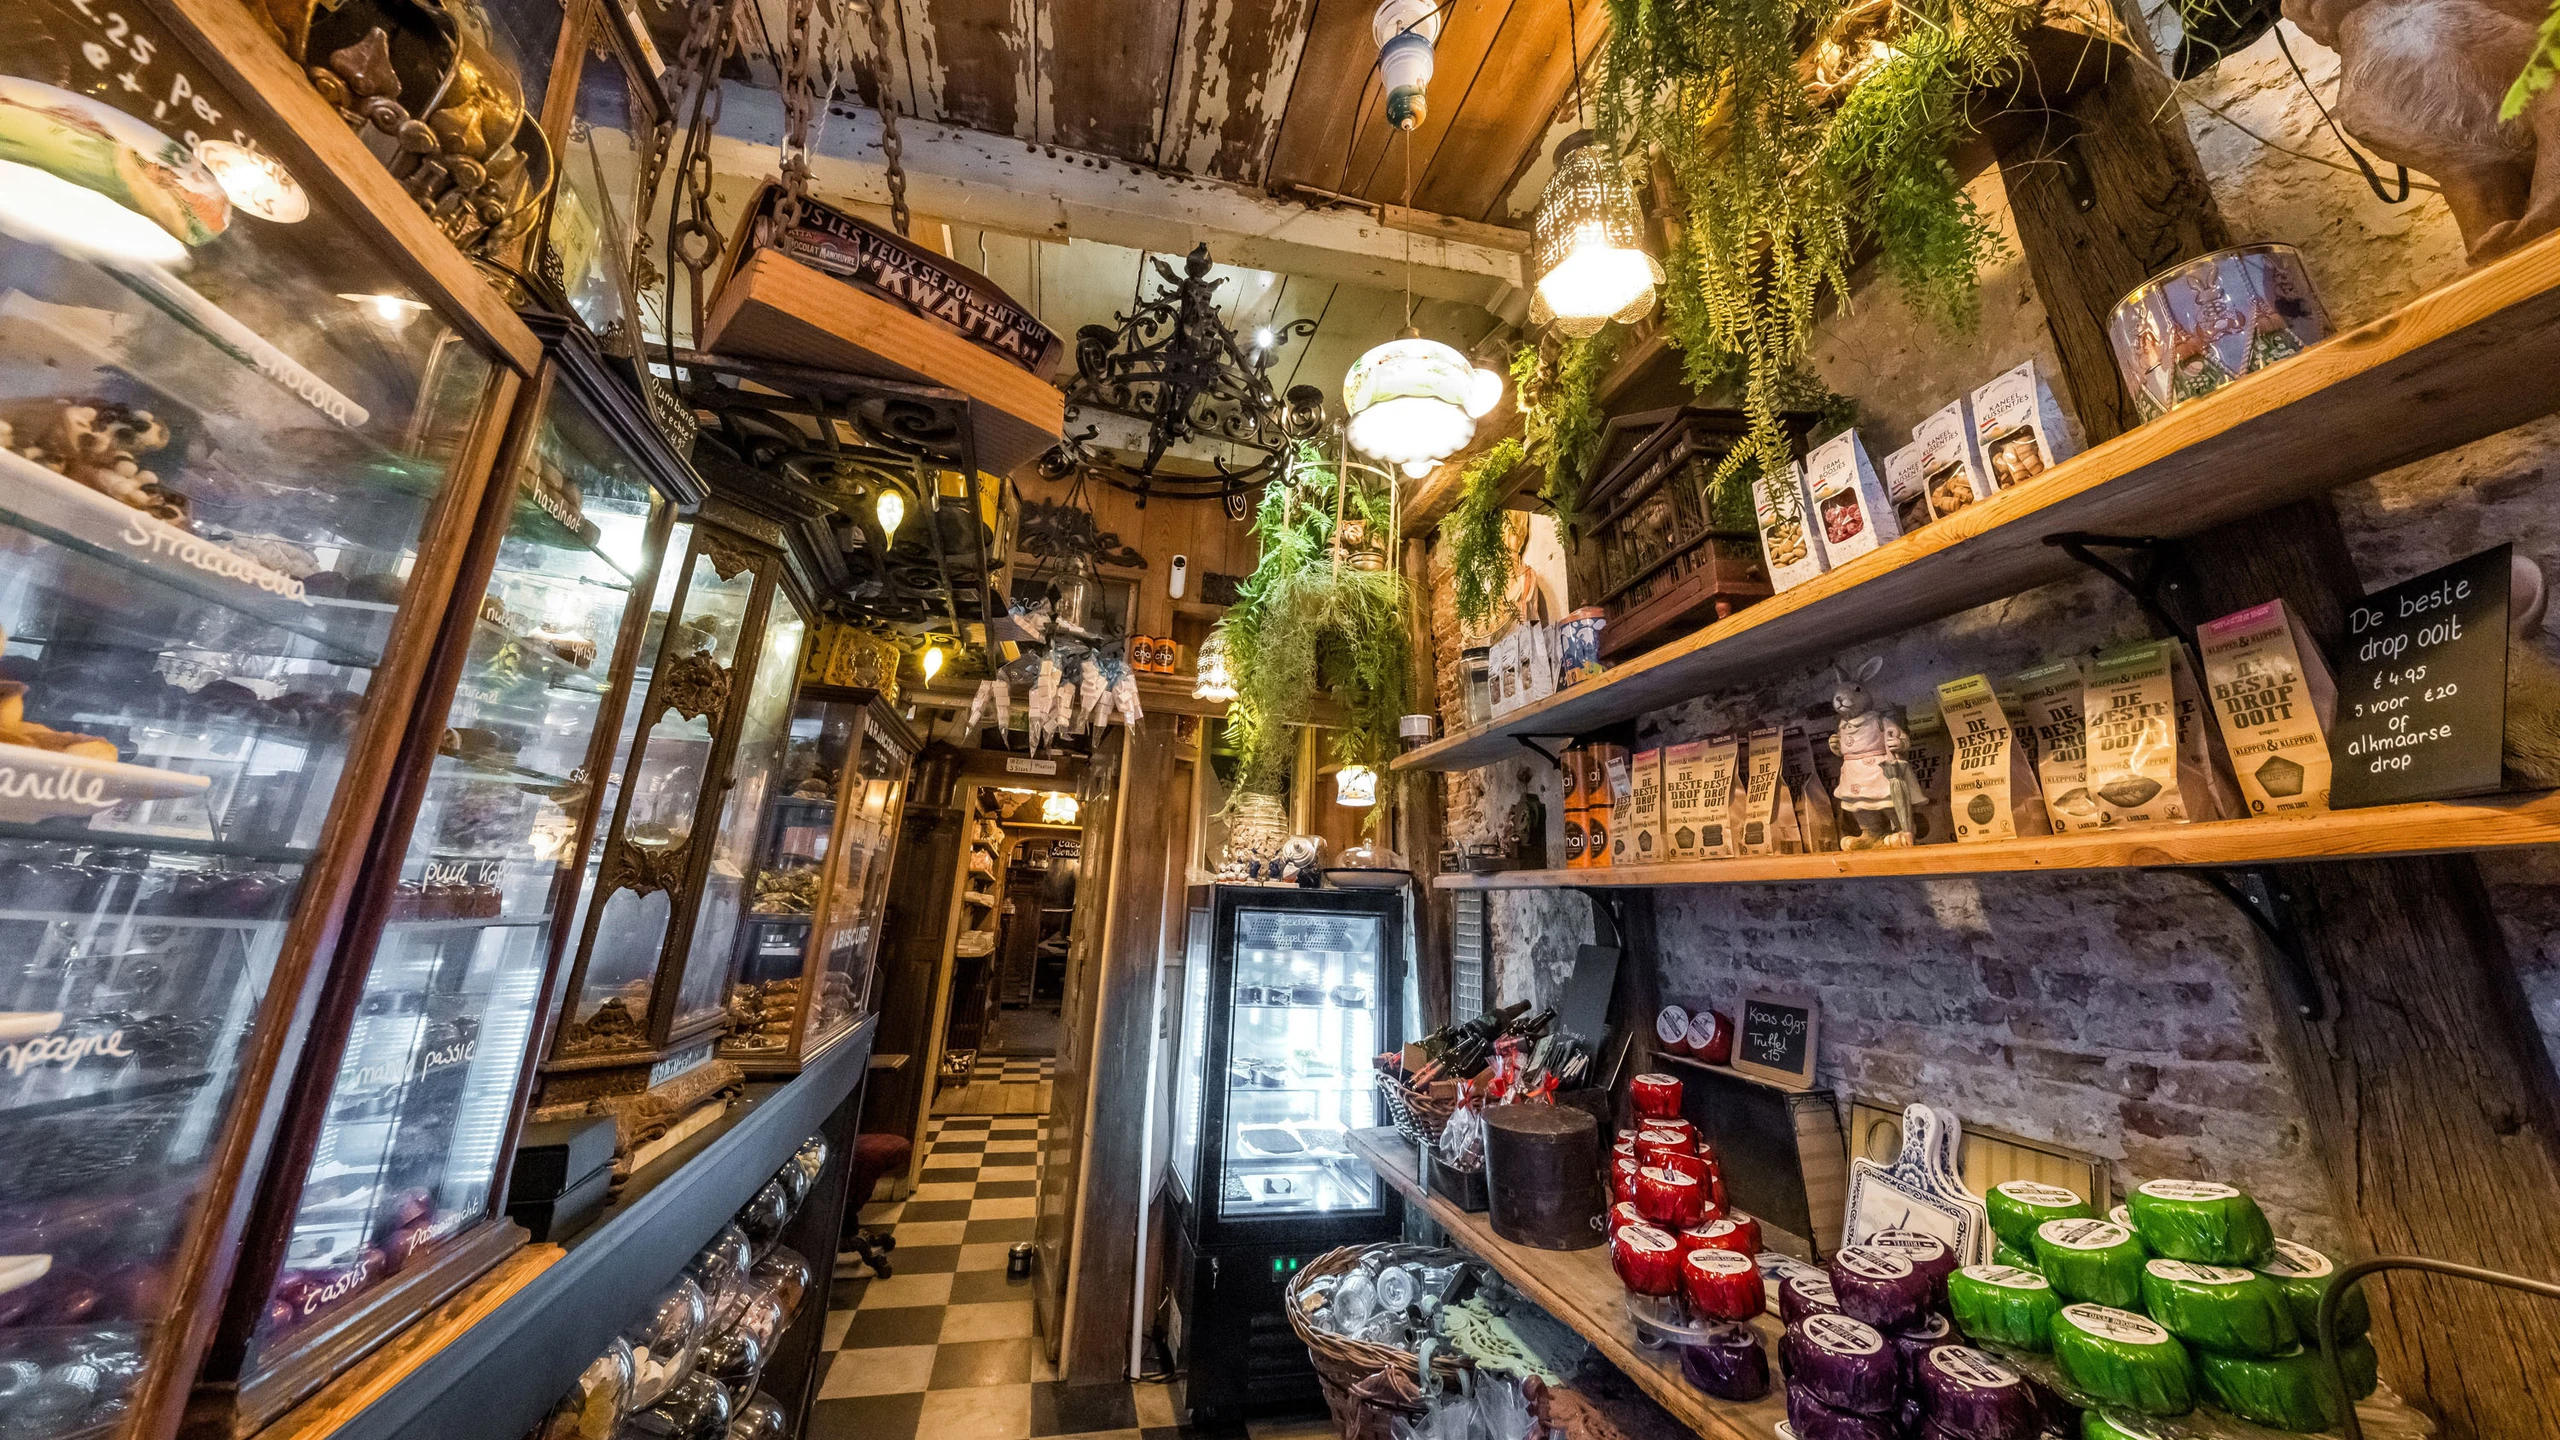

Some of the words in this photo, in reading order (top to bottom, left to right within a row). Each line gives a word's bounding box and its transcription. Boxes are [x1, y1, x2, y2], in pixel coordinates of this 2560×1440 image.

[169, 73, 222, 126] per
[828, 217, 862, 246] LES
[868, 236, 917, 276] YEUX
[919, 264, 939, 289] SE
[943, 278, 1017, 328] PORENT
[1018, 318, 1046, 343] SUR
[1982, 393, 2030, 423] KUSSENTJES
[1989, 392, 2021, 412] KANEEL
[1922, 429, 1959, 456] KUSSENTJES
[1927, 429, 1951, 448] KANEEL
[1819, 460, 1847, 480] BOOSJES
[1822, 458, 1841, 472] FRAM
[1898, 461, 1919, 477] KANEE
[1893, 466, 1921, 487] KUSSENT
[532, 476, 581, 533] hazelnoot
[2350, 607, 2384, 634] De
[2400, 579, 2471, 618] beste
[2239, 635, 2250, 648] &
[2360, 634, 2408, 662] drop
[2418, 613, 2462, 647] ooit
[2120, 673, 2131, 685] &
[2213, 671, 2298, 701] BESTE
[2111, 692, 2143, 709] DE
[2223, 684, 2294, 715] DROP
[2354, 704, 2363, 717] 5
[2371, 696, 2410, 714] voor
[2424, 683, 2458, 702] €20
[2048, 704, 2078, 723] DE
[2091, 702, 2169, 728] BESTE
[2232, 702, 2294, 730] OOIT
[1966, 717, 1990, 734] DE
[2038, 716, 2087, 741] BEST
[2388, 714, 2410, 733] of
[1956, 726, 2009, 750] BESTE
[2235, 743, 2267, 757] KLEPPER
[2266, 738, 2279, 752] &
[2279, 732, 2316, 747] KLEPPER
[2347, 724, 2452, 756] alkmaarse
[1959, 741, 2004, 761] DROP
[1759, 762, 1771, 774] DE
[1960, 753, 1999, 771] OOIT
[2370, 754, 2412, 774] drop
[1642, 777, 1653, 787] DE
[1678, 771, 1693, 781] DE
[1703, 775, 1731, 790] BESTE
[1714, 768, 1726, 780] DE
[1750, 770, 1777, 786] BESTE
[1975, 778, 1983, 789] &
[1633, 784, 1659, 798] BESTE
[1667, 779, 1702, 792] BESTE
[1671, 789, 1700, 800] DROP
[1704, 786, 1727, 799] DROP
[1749, 781, 1772, 794] DROP
[1635, 794, 1657, 805] DROP
[1672, 799, 1699, 809] OOIT
[1704, 796, 1726, 808] OOIT
[1748, 791, 1768, 804] OOIT
[1636, 803, 1656, 814] OOIT
[1749, 1032, 1788, 1051] Truffel
[420, 1040, 476, 1083] passie
